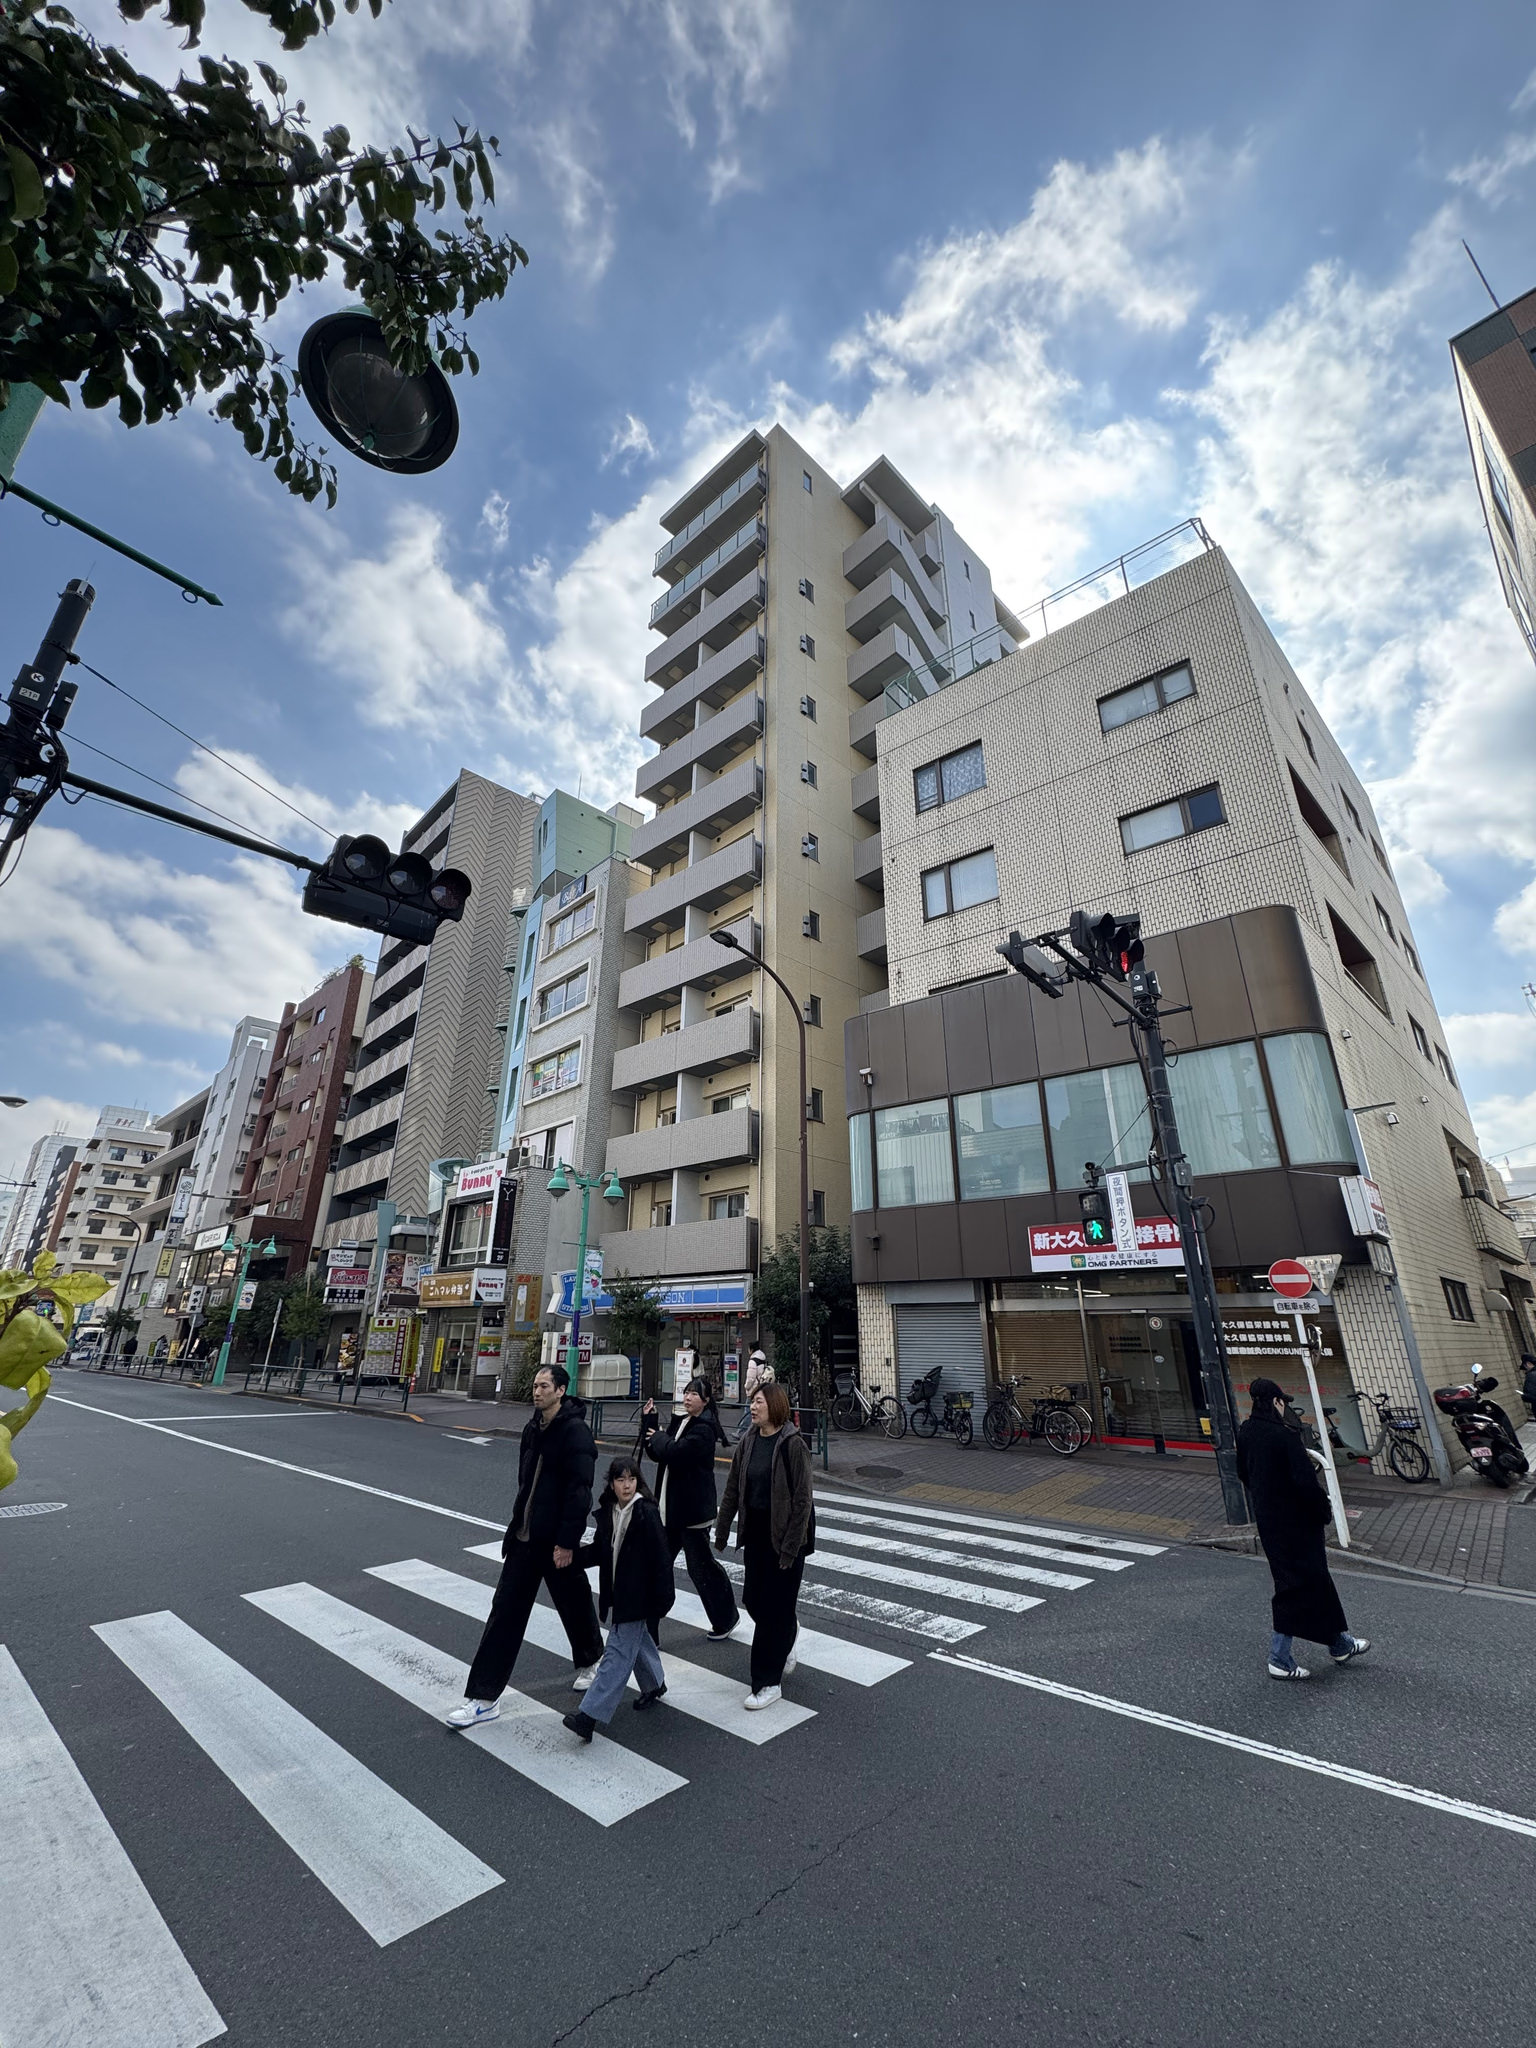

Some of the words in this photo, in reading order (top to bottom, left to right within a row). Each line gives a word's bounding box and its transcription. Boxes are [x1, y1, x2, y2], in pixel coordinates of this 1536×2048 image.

[1112, 1176, 1132, 1249] 夜間押ボタン式
[1034, 1223, 1181, 1250] 新大久接骨
[1088, 1260, 1107, 1268] OMG
[1109, 1258, 1158, 1267] PARTNERS
[1276, 1301, 1317, 1311] 自転車を除く
[1211, 1321, 1290, 1329] 大久保協栄接骨院
[560, 1335, 591, 1345] 酒・ばこ
[1213, 1333, 1293, 1342] 大久保協栄整体院
